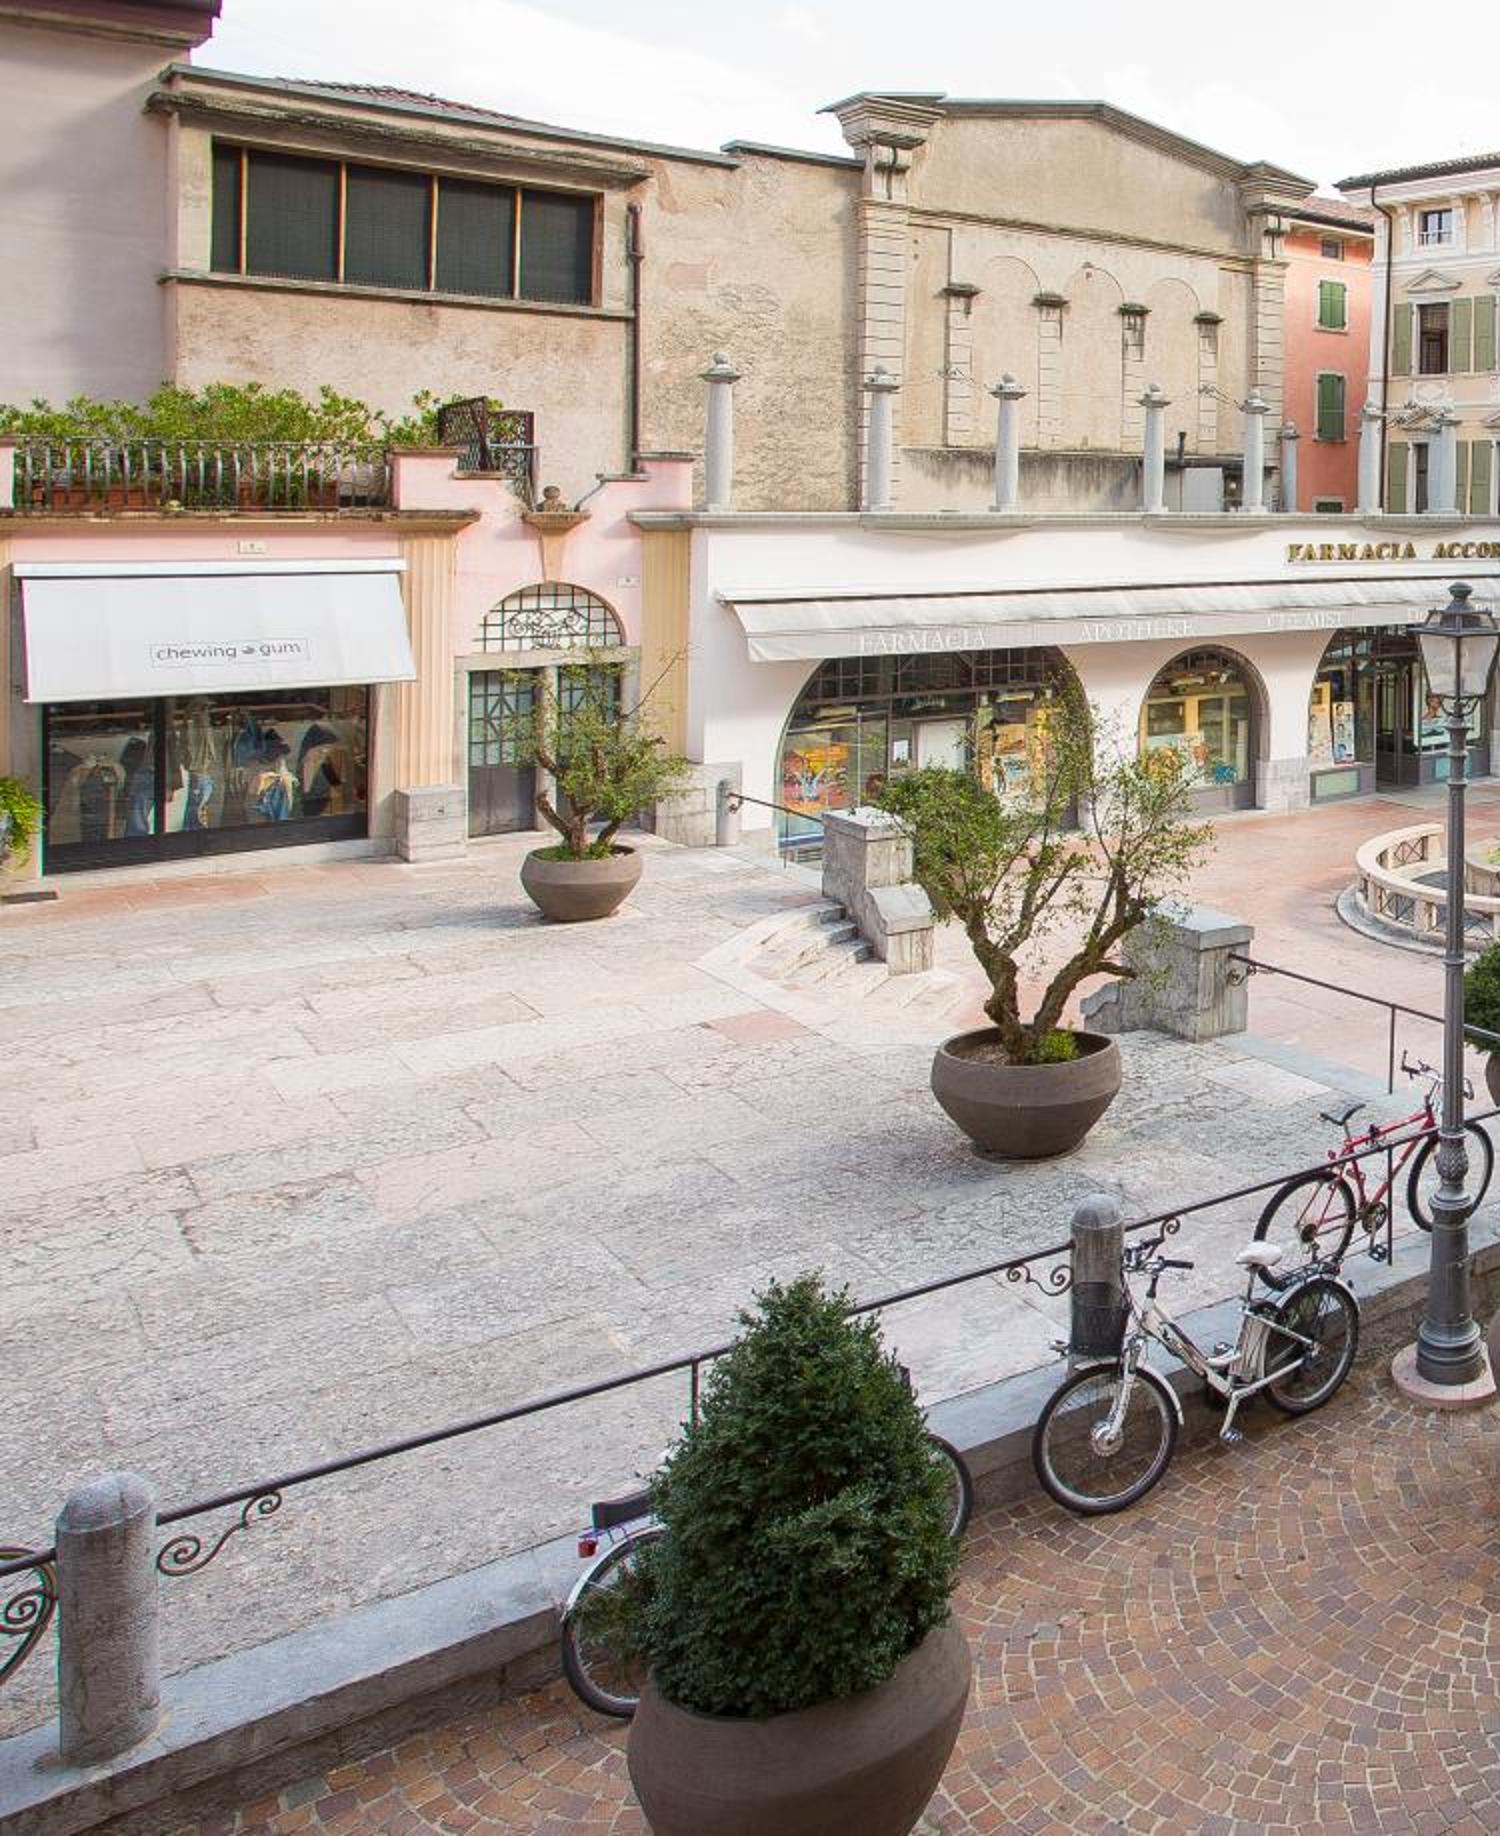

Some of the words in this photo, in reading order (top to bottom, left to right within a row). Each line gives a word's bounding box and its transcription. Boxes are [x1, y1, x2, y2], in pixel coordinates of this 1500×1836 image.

[1288, 541, 1417, 562] FARMACIA
[860, 628, 986, 651] FARMACIA
[157, 646, 237, 660] chewing
[259, 642, 301, 656] gum
